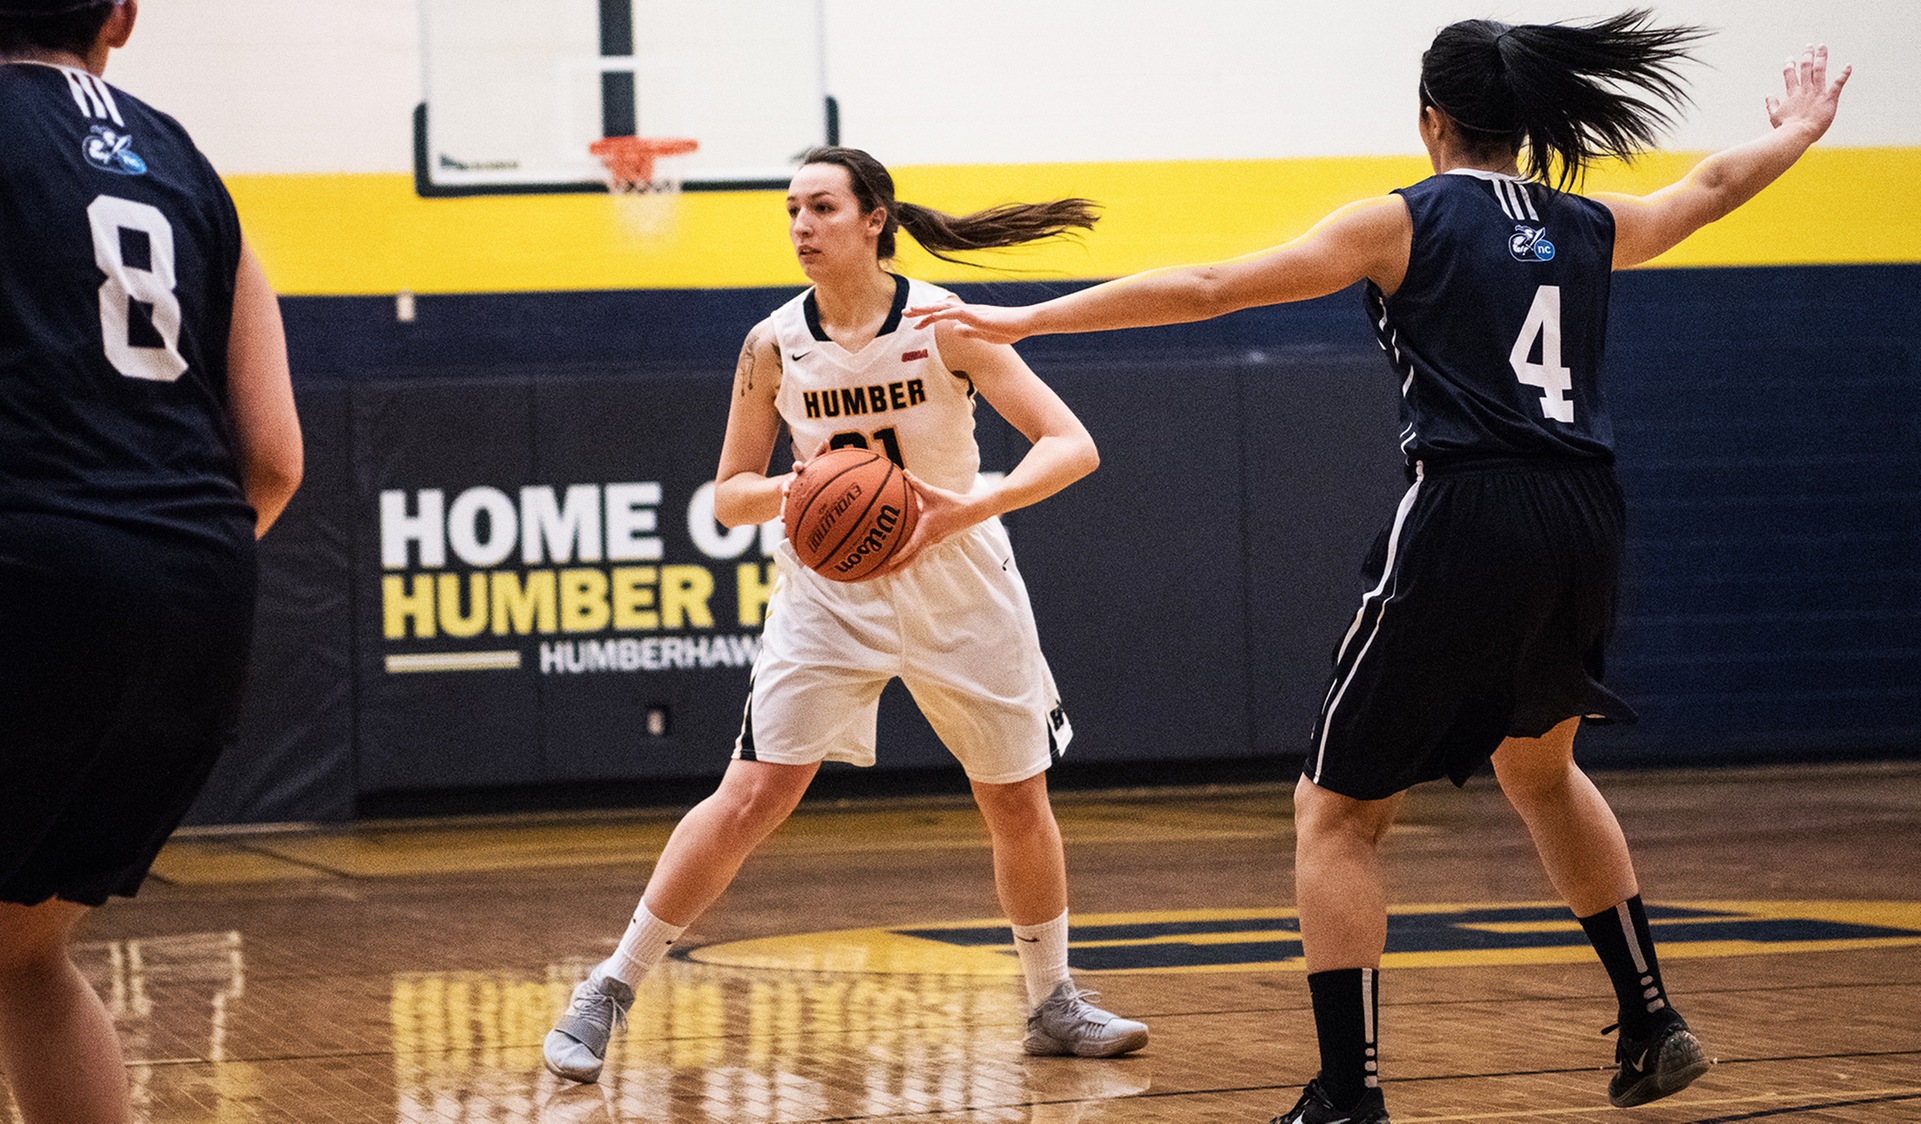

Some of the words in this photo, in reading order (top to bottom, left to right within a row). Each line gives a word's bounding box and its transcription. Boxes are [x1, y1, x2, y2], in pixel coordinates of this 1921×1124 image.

[1538, 245, 1552, 254] nc
[87, 194, 189, 382] 8
[1509, 285, 1574, 423] 4
[803, 377, 927, 419] HUMBER
[828, 424, 907, 470] 1
[379, 482, 664, 569] HOME
[808, 482, 863, 553] EVOLUTION
[834, 503, 900, 574] Wilson
[382, 563, 714, 639] HUMBER
